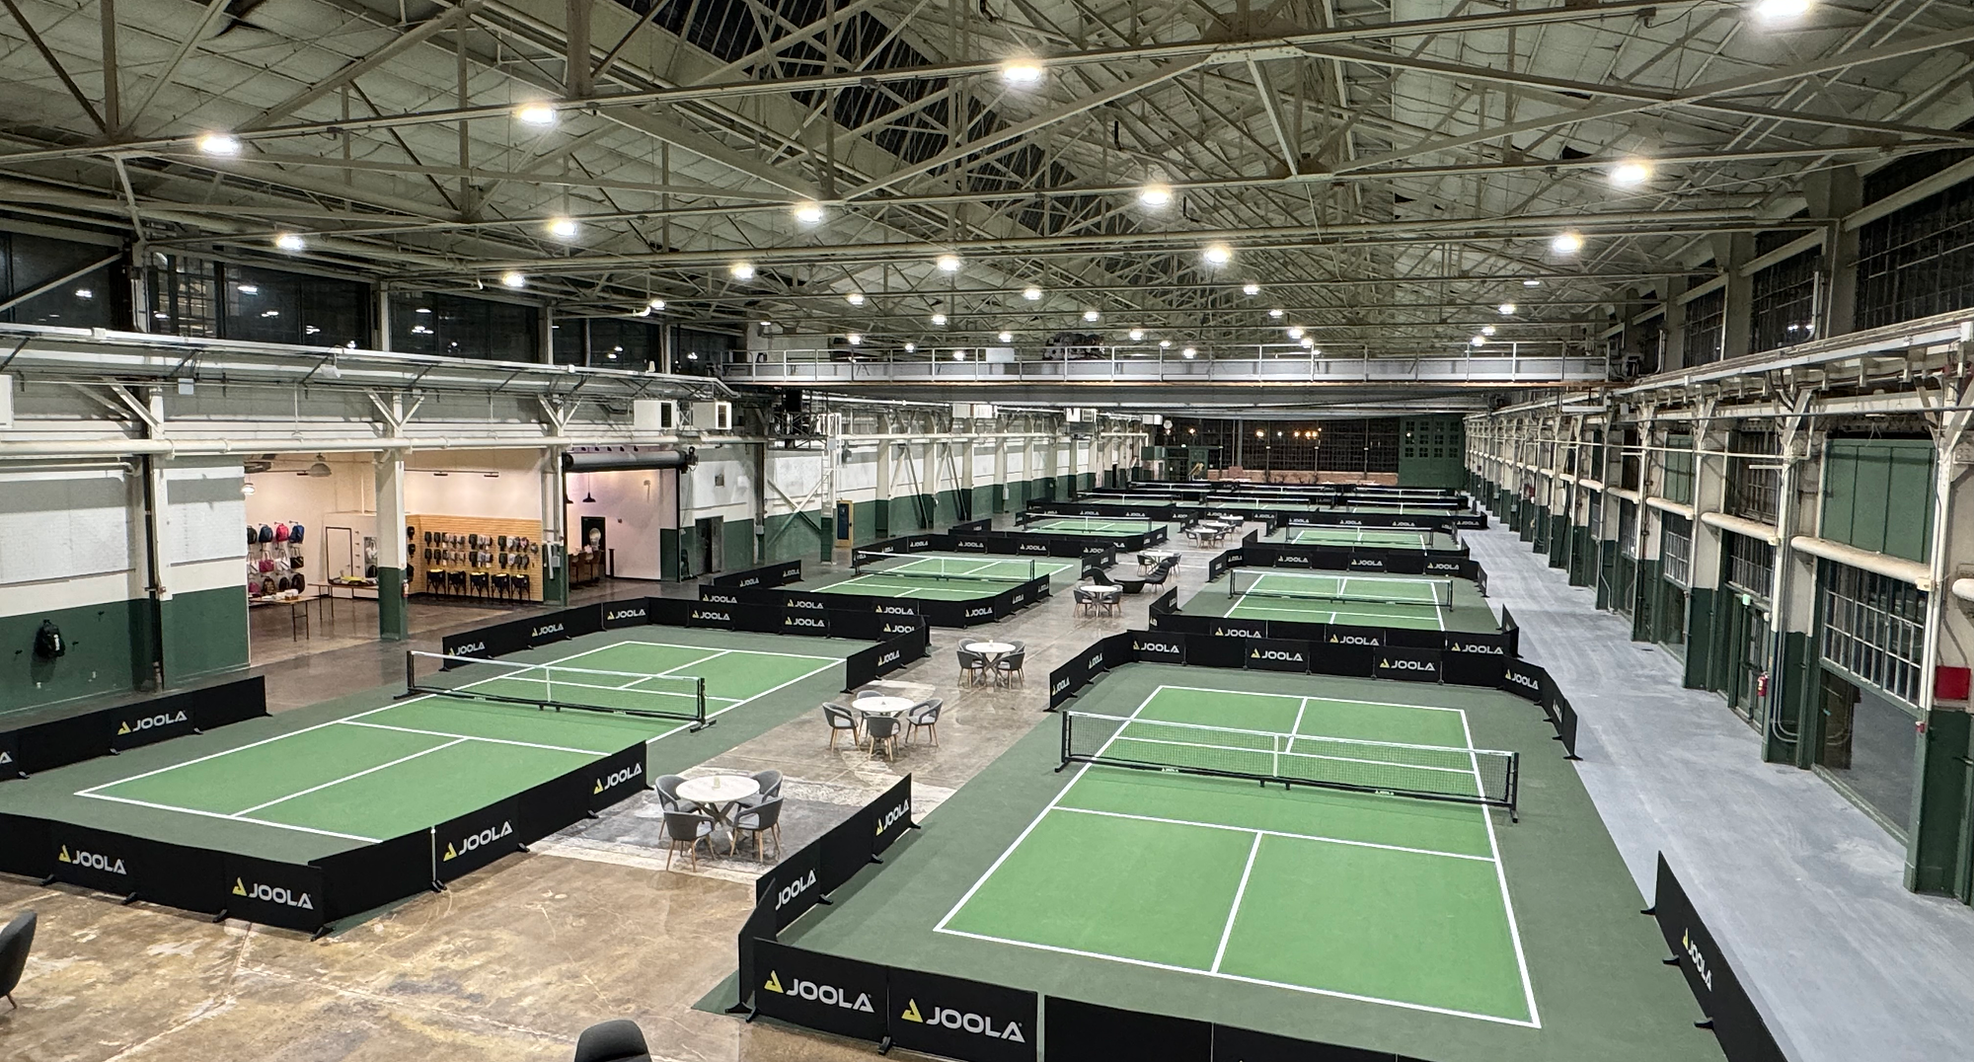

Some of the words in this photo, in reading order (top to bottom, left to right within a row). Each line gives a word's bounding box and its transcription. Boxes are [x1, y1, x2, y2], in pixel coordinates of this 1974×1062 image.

[709, 595, 738, 604] JOOLA
[794, 601, 824, 609] JOOLA
[615, 609, 646, 619] JOOLA
[700, 612, 730, 621] JOOLA
[884, 606, 914, 615] JOOLA
[969, 607, 993, 617] JOOLA
[793, 617, 825, 627] JOOLA
[539, 623, 564, 636] JOOLA
[1225, 628, 1262, 638] JOOLA
[1340, 635, 1379, 646] JOOLA
[456, 642, 485, 656] JOOLA
[1141, 643, 1179, 653] JOOLA
[1462, 645, 1503, 654] JOOLA
[881, 650, 900, 664] JOOLA
[1261, 650, 1303, 661] JOOLA
[1391, 660, 1435, 671] JOOLA
[1056, 677, 1070, 693] JOOLA
[1512, 673, 1539, 690] JOOLA
[133, 711, 188, 731] JOOLA
[603, 762, 642, 791] JOOLA
[883, 799, 909, 829] JOOLA
[458, 820, 513, 857] JOOLA
[72, 850, 127, 875] JOOLA
[775, 869, 816, 910] JOOLA
[249, 884, 313, 911] JOOLA
[1688, 941, 1712, 991] JOOLA
[787, 979, 875, 1012] JOOLA
[926, 1006, 1025, 1044] JOOLA
